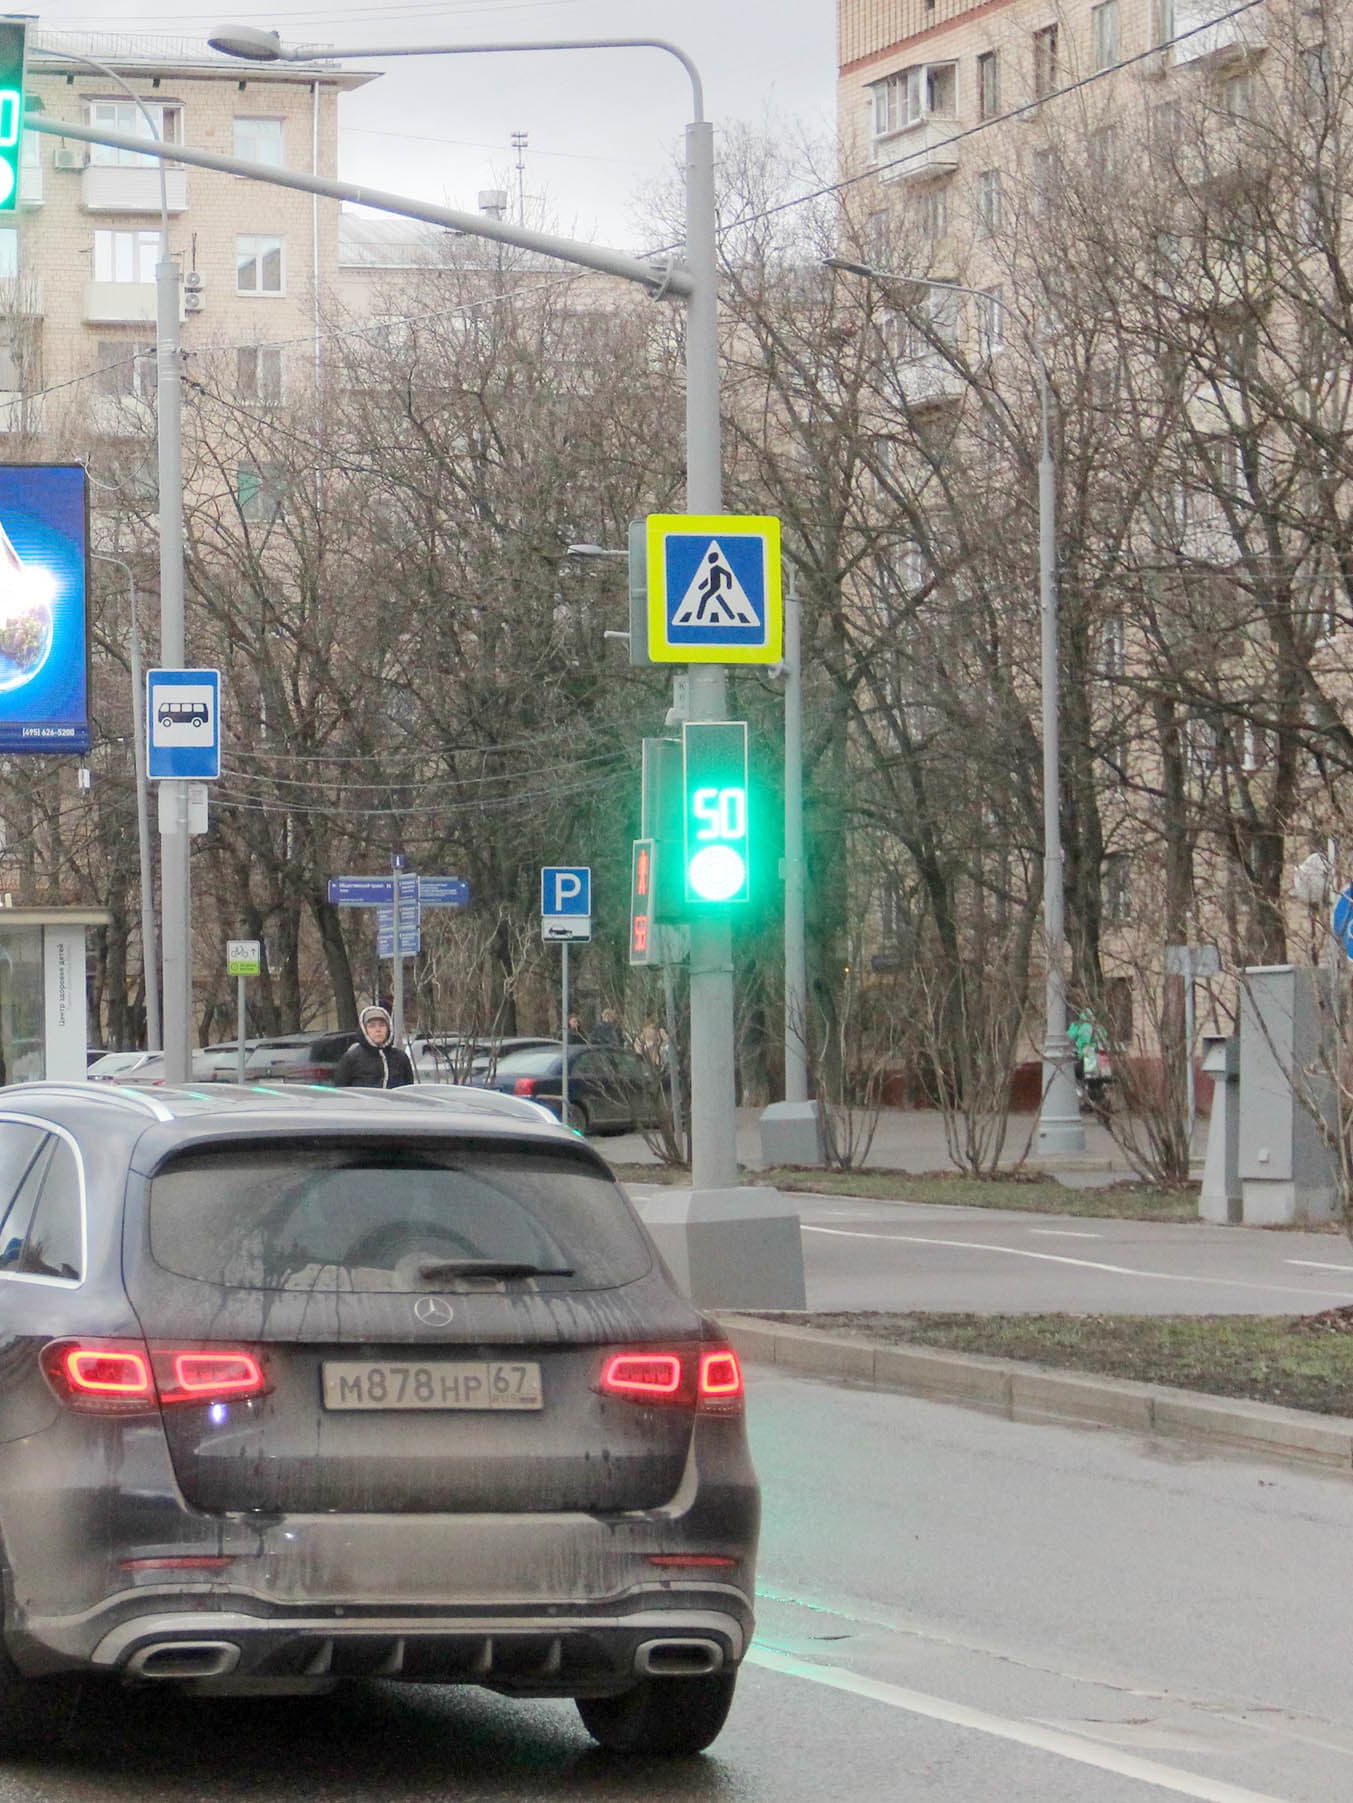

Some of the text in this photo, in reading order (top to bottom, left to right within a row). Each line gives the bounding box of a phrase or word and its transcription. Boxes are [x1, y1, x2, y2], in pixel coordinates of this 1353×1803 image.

[693, 788, 746, 839] 50
[555, 873, 581, 912] P
[339, 1366, 527, 1403] М878НР 67
